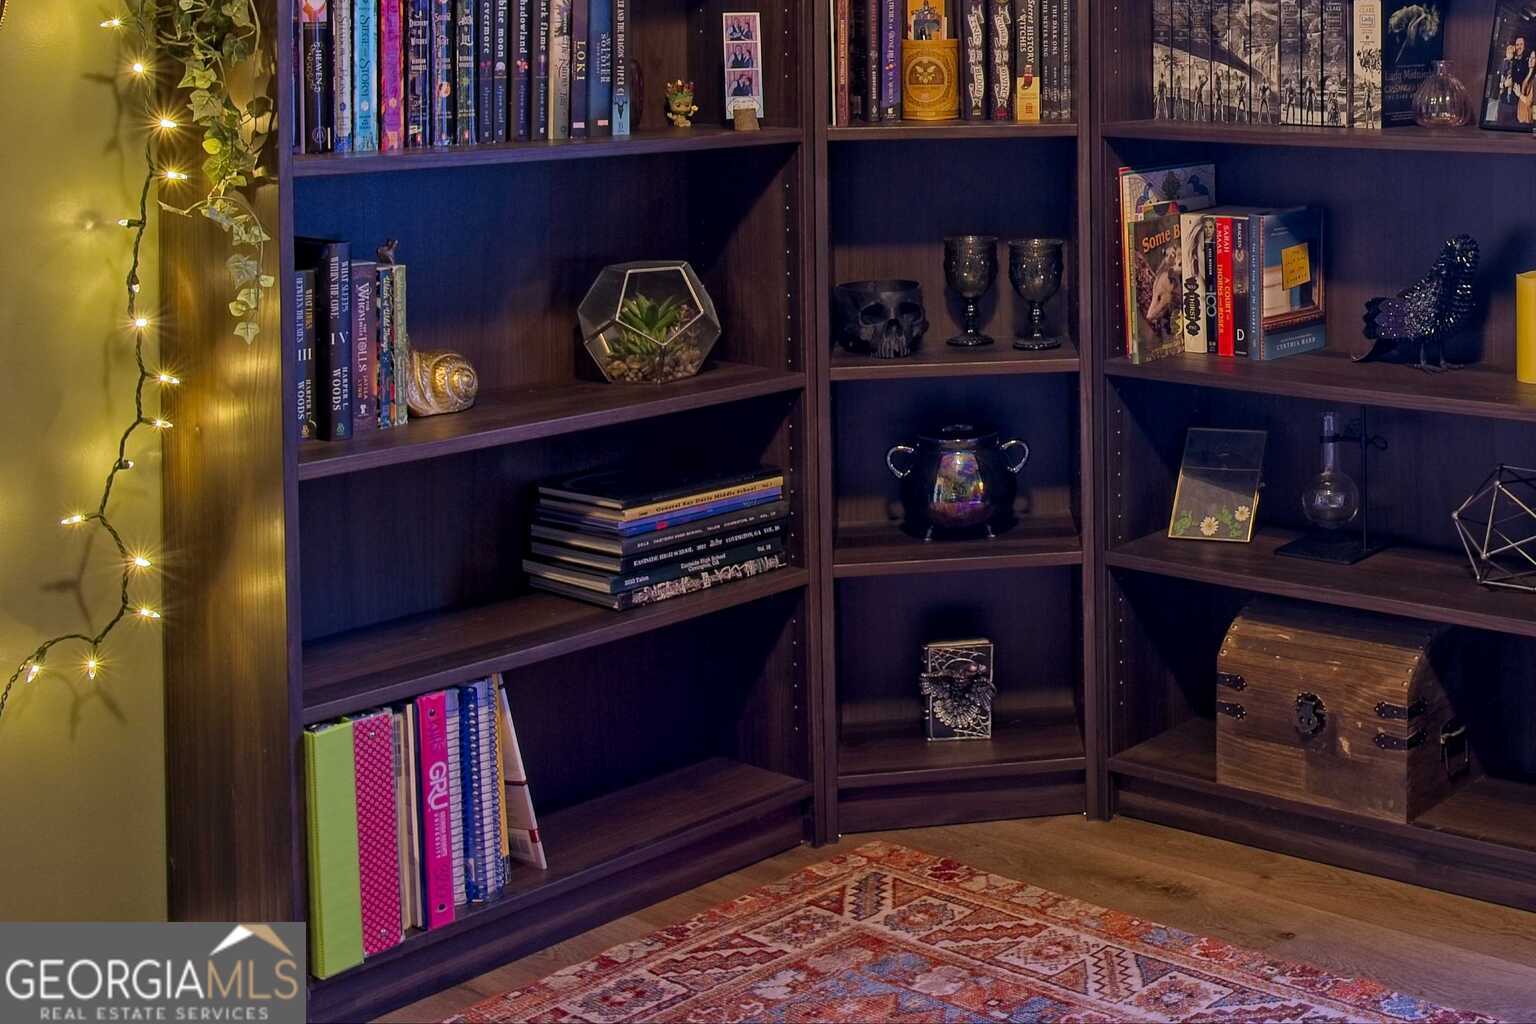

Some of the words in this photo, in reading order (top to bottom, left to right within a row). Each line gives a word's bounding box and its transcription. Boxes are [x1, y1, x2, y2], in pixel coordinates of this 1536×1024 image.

[498, 0, 507, 23] blue
[540, 22, 549, 51] flame
[616, 34, 625, 58] DRAGON
[1017, 13, 1027, 52] WITCHES
[1026, 26, 1034, 63] HISTORY
[314, 49, 323, 85] HEAVEN
[359, 58, 370, 97] STORM
[576, 40, 586, 80] LOKI
[616, 65, 625, 86] PIPER
[1142, 229, 1170, 253] Some
[297, 380, 305, 421] WOODS
[332, 368, 341, 411] WOODS
[656, 501, 681, 513] General
[714, 491, 735, 501] Middle
[736, 486, 757, 496] School
[427, 761, 449, 811] GRU
